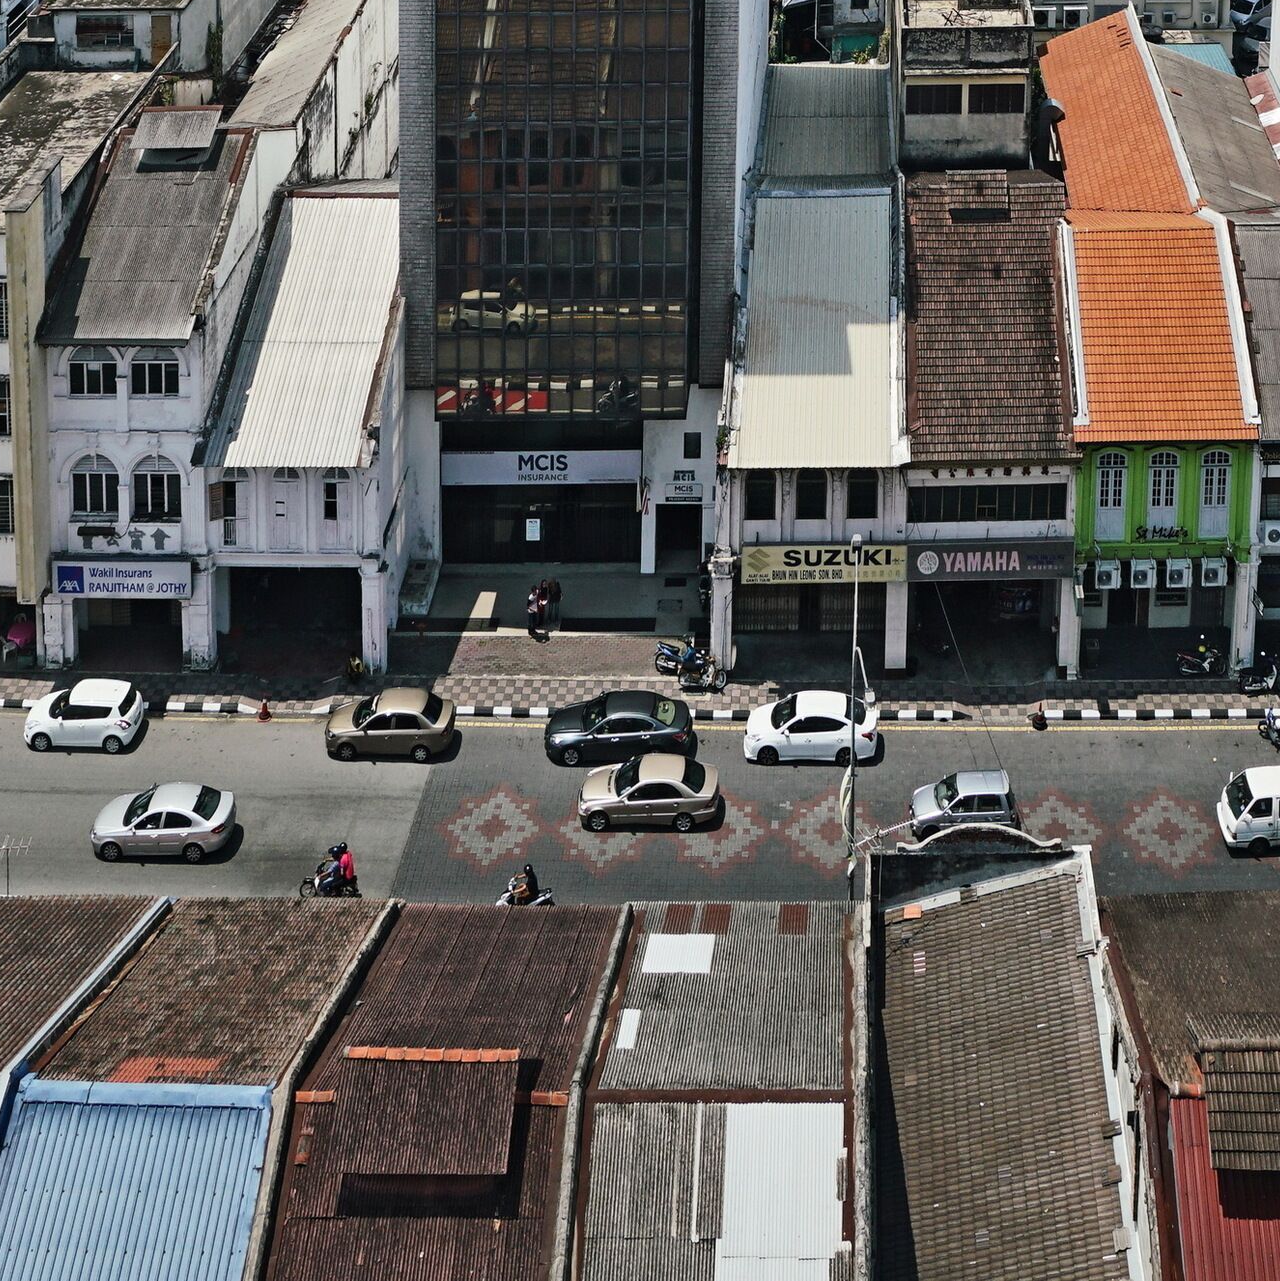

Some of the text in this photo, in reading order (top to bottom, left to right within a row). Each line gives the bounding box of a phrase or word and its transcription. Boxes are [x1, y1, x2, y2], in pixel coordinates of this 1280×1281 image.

[518, 454, 568, 471] MCIS
[518, 473, 568, 481] INSURANCE
[783, 549, 892, 567] SUZUKI
[943, 551, 1020, 572] YAMAHA
[89, 568, 152, 578] Wakil Insurans
[772, 570, 787, 580] BHUN
[788, 570, 798, 579] HIN
[800, 570, 816, 580] LEONG
[58, 580, 80, 592] AXA
[88, 583, 187, 593] RANJITHAM @ JOTHY
